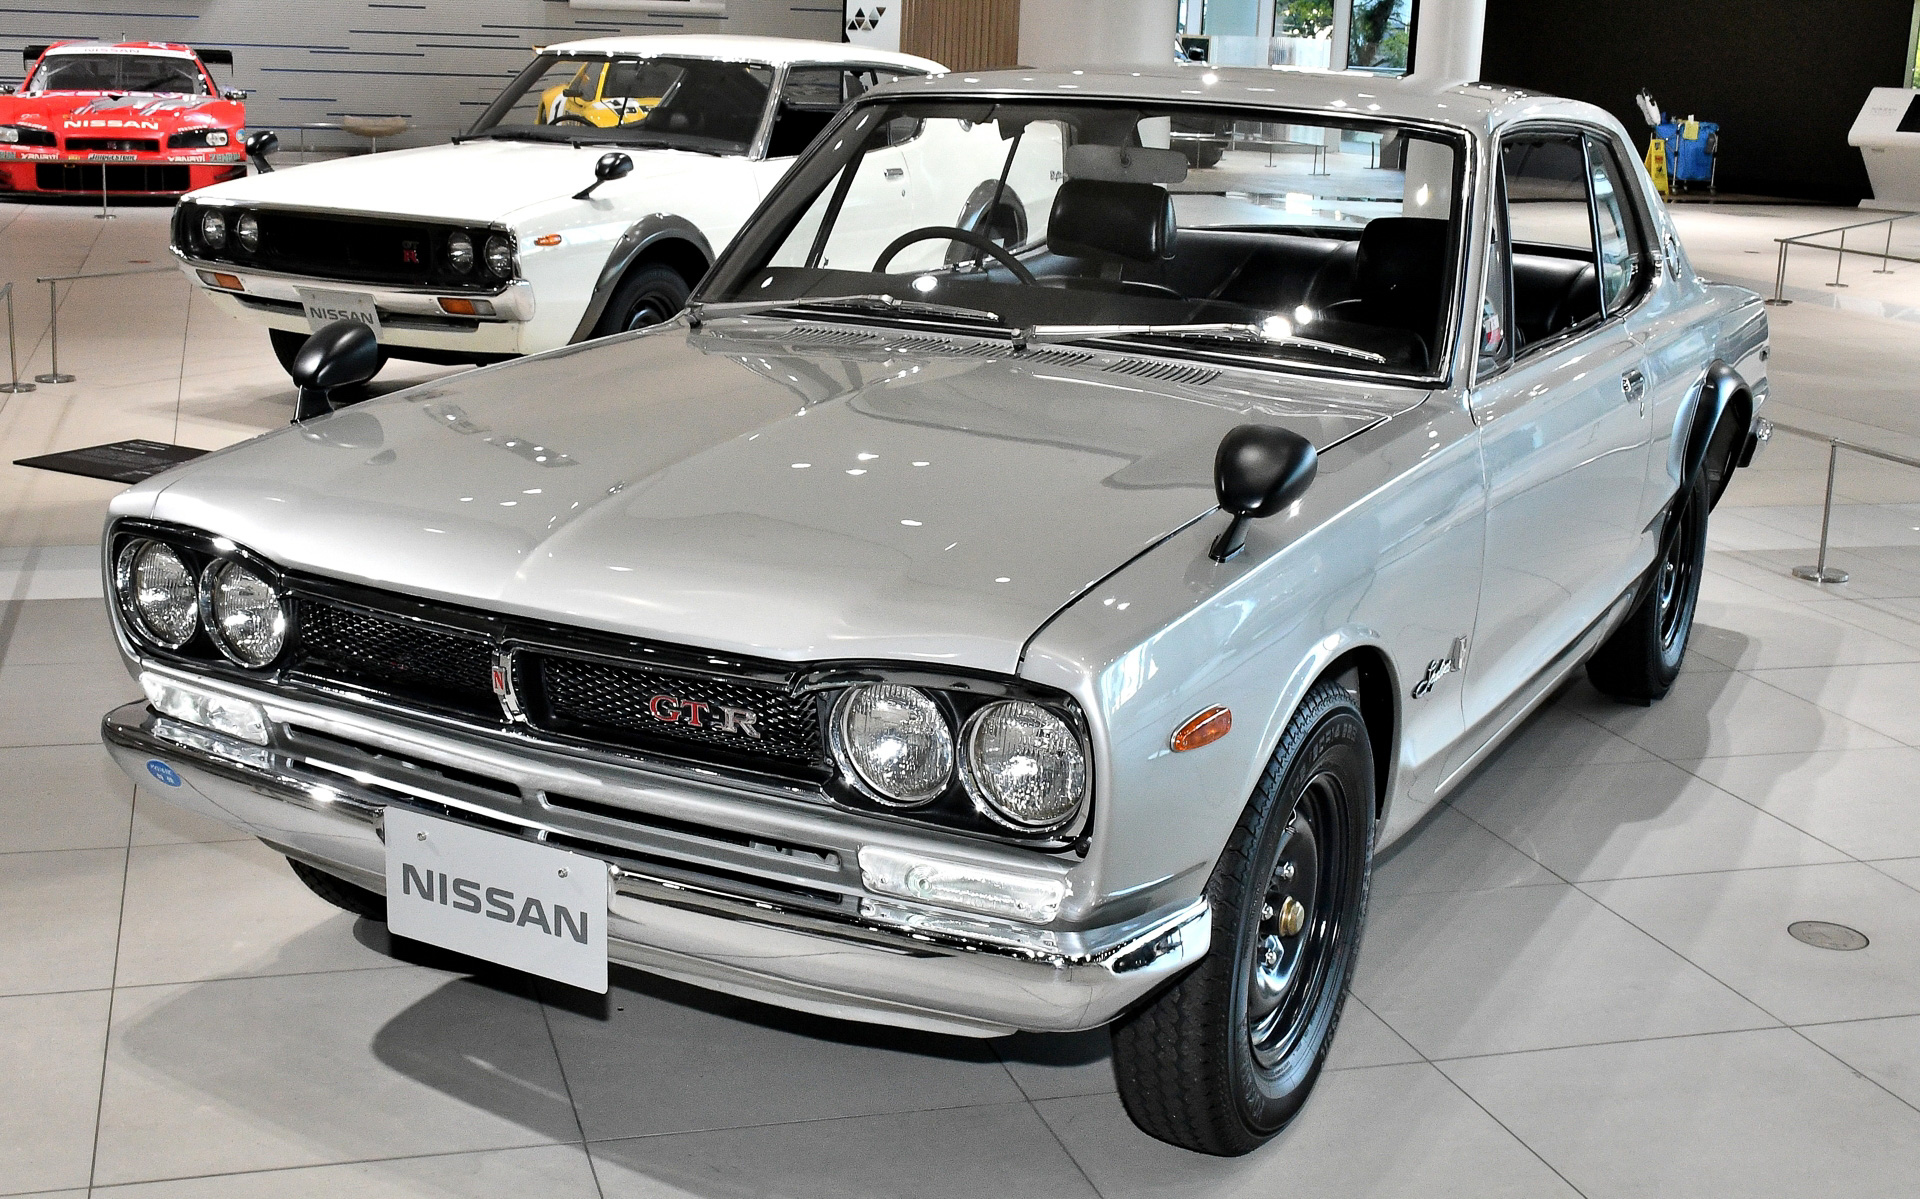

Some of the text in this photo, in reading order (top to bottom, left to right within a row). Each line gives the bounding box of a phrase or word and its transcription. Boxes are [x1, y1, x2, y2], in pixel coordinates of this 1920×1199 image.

[63, 120, 159, 130] NISSAN
[310, 307, 374, 325] NISSAN
[402, 862, 588, 945] NISSAN
